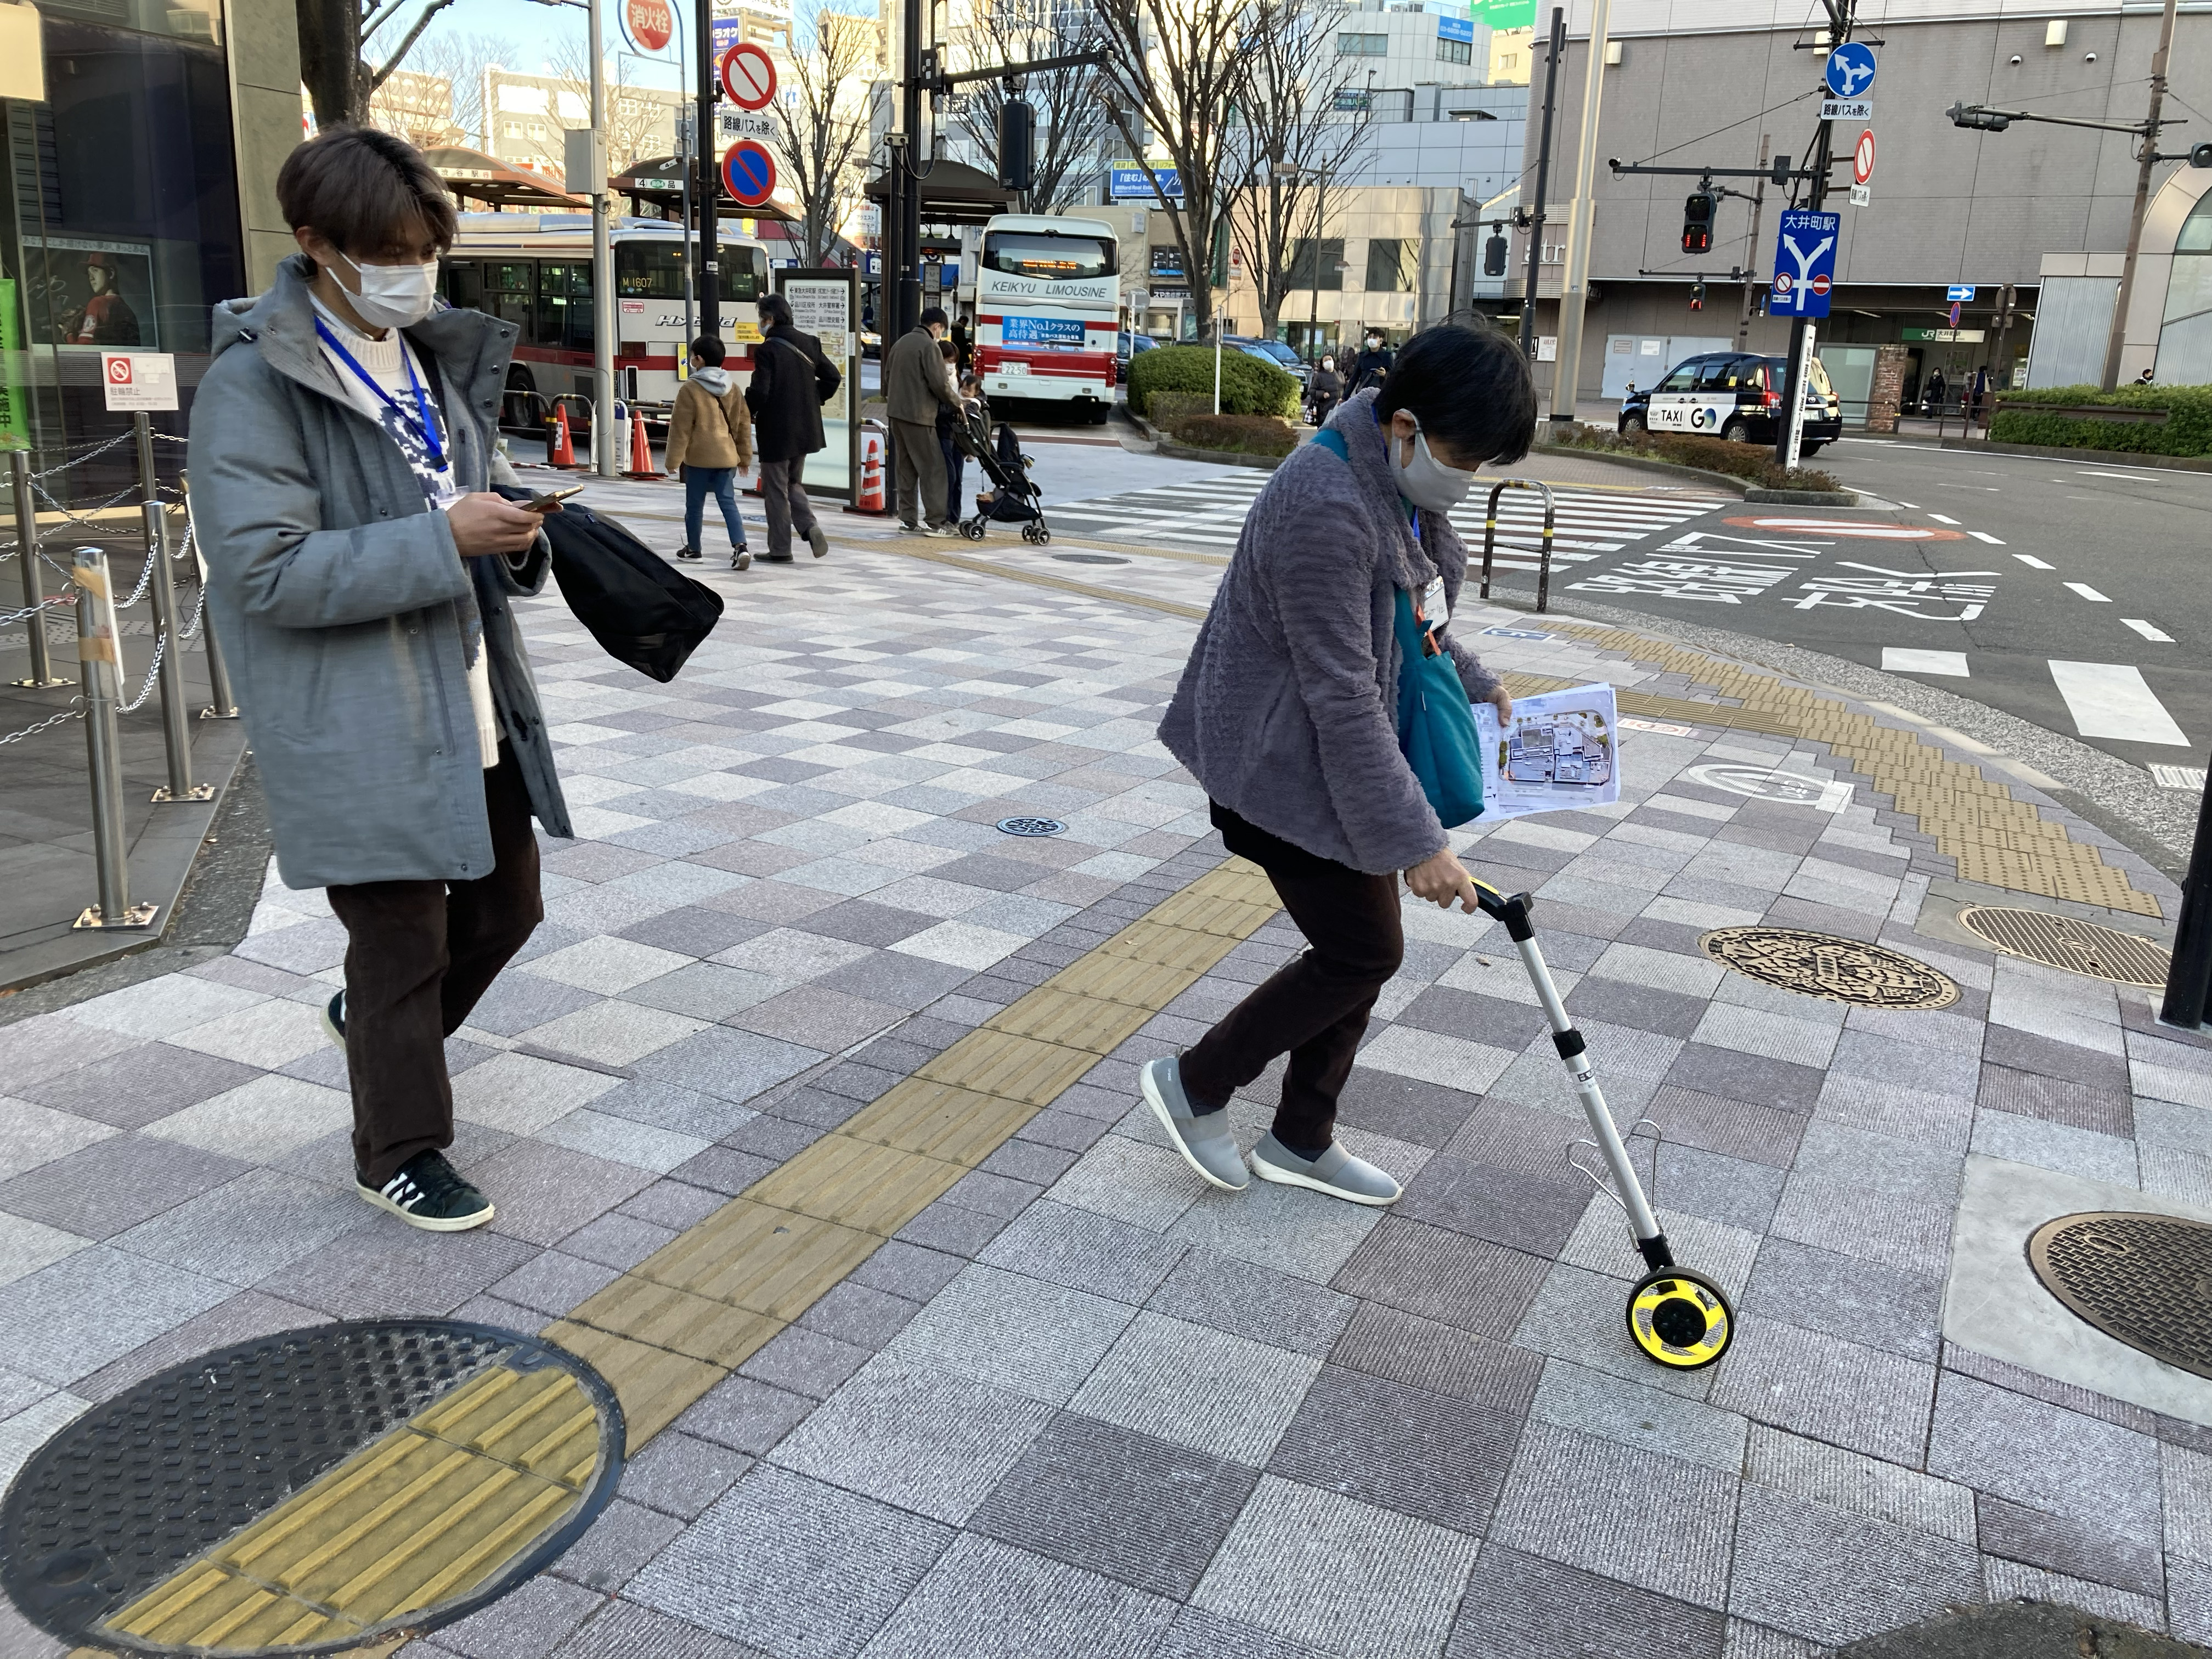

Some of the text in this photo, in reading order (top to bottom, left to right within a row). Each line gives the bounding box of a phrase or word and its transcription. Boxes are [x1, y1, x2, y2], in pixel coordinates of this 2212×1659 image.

[630, 3, 669, 33] 消火栓
[713, 27, 738, 40] ラオケ
[1824, 103, 1869, 117] 路線バスを除く
[724, 116, 775, 137] 路線バスを除く
[1785, 215, 1836, 230] 大井町駅
[633, 278, 652, 288] 1607
[991, 281, 1107, 298] KEIKYU LIMOUSINE
[1009, 318, 1080, 332] 業界No.1クラスの
[1008, 329, 1038, 340] 高待遇
[1921, 330, 1936, 338] JR
[1006, 366, 1026, 375] 22-50
[1661, 410, 1683, 422] TAXI
